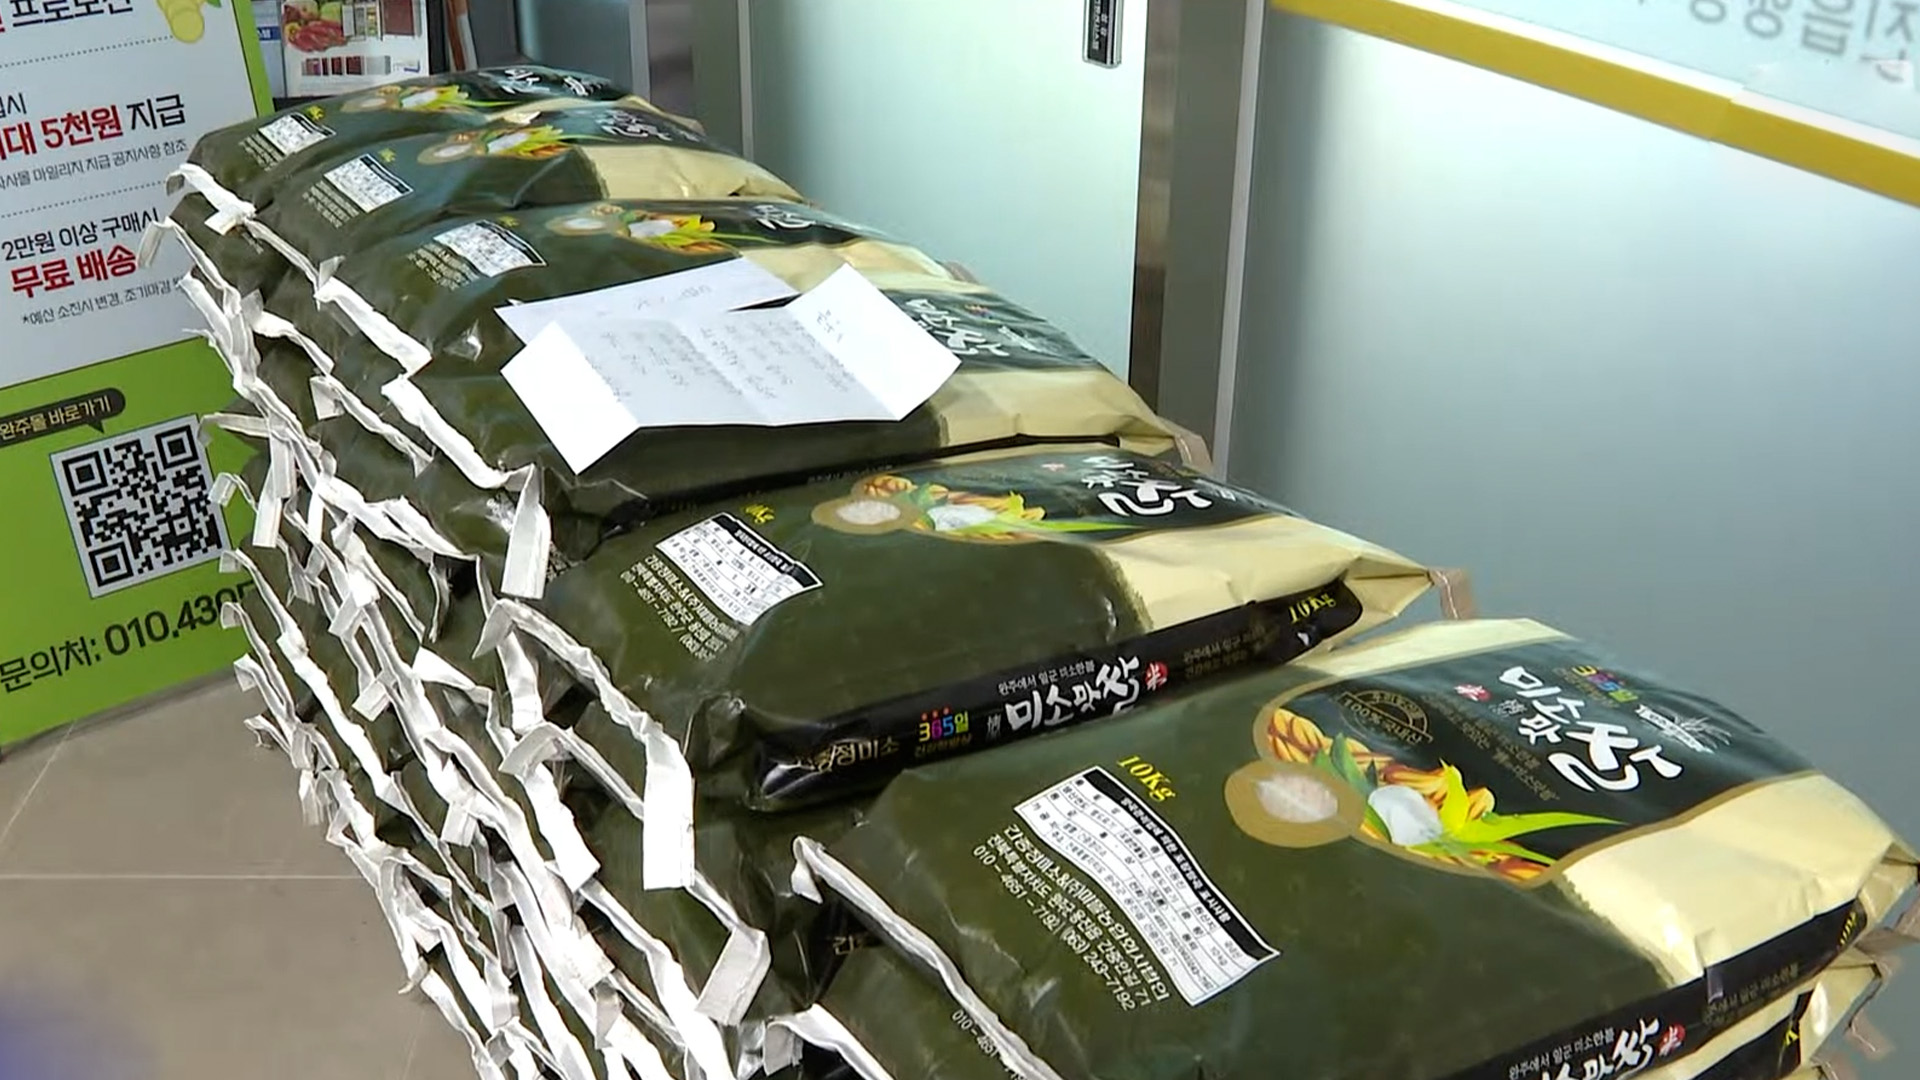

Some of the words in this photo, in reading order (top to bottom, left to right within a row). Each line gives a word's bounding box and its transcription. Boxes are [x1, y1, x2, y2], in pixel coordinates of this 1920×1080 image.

[0, 121, 37, 160] 대
[41, 105, 123, 149] 5천원
[126, 94, 186, 130] 지급
[33, 159, 84, 182] 마일리지
[86, 154, 111, 171] 지급
[112, 143, 161, 167] 공지사항
[163, 139, 187, 156] 참조
[4, 231, 55, 261] 2만원
[59, 222, 98, 247] 이상
[102, 207, 159, 239] 구매시
[11, 258, 74, 298] 무료
[78, 244, 136, 281] 배송
[58, 298, 95, 318] 소진시
[125, 280, 171, 303] 조기마감
[0, 413, 47, 440] 완주몰
[48, 395, 111, 424] 바로가기
[1289, 593, 1336, 624] 10Kg
[0, 637, 101, 693] 문의처:
[999, 675, 1037, 696] 완주에서
[1038, 668, 1058, 684] 일군
[919, 711, 969, 742] 365일
[1116, 754, 1177, 802] 10Kg
[984, 833, 1052, 898] 전북특별자치도
[1098, 941, 1141, 986] 간중안길
[1134, 989, 1153, 1006] 71
[1198, 887, 1231, 924] 표시사항
[973, 846, 996, 865] 010
[1001, 873, 1028, 899] 4651
[1062, 927, 1091, 956] (063)
[1082, 954, 1137, 1011] 243-7192
[952, 1009, 972, 1029] 010
